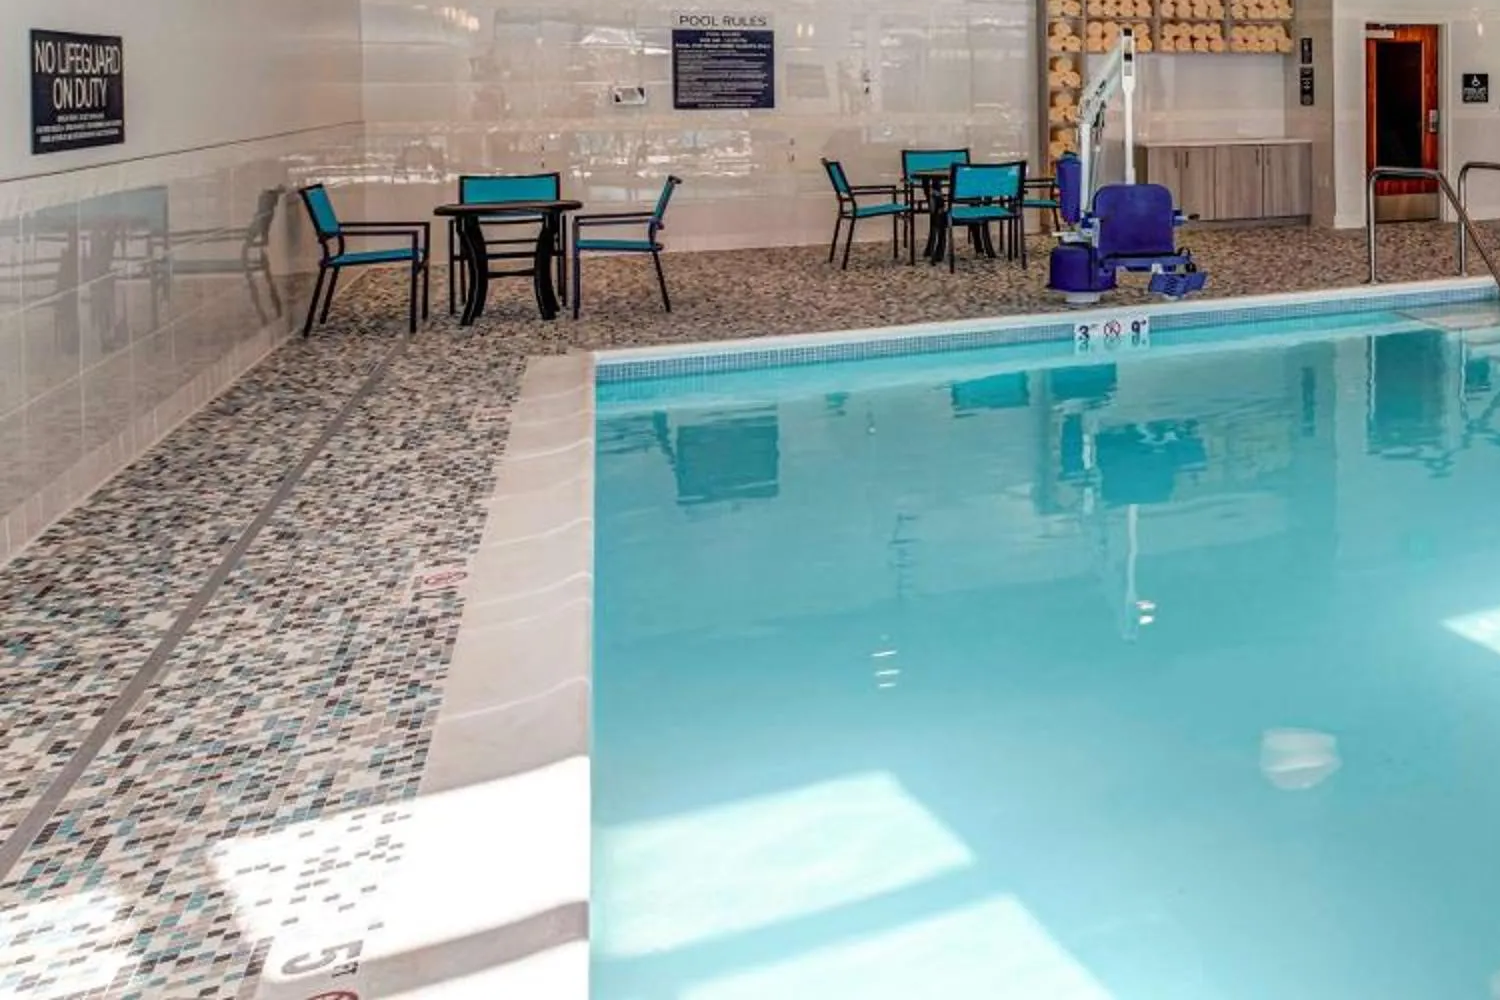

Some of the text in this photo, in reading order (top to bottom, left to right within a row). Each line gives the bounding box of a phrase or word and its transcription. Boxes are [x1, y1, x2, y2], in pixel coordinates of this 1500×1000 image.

[679, 15, 767, 26] POOL RULES
[35, 40, 121, 75] NO LIFEGUARD
[53, 78, 108, 109] ON DUTY
